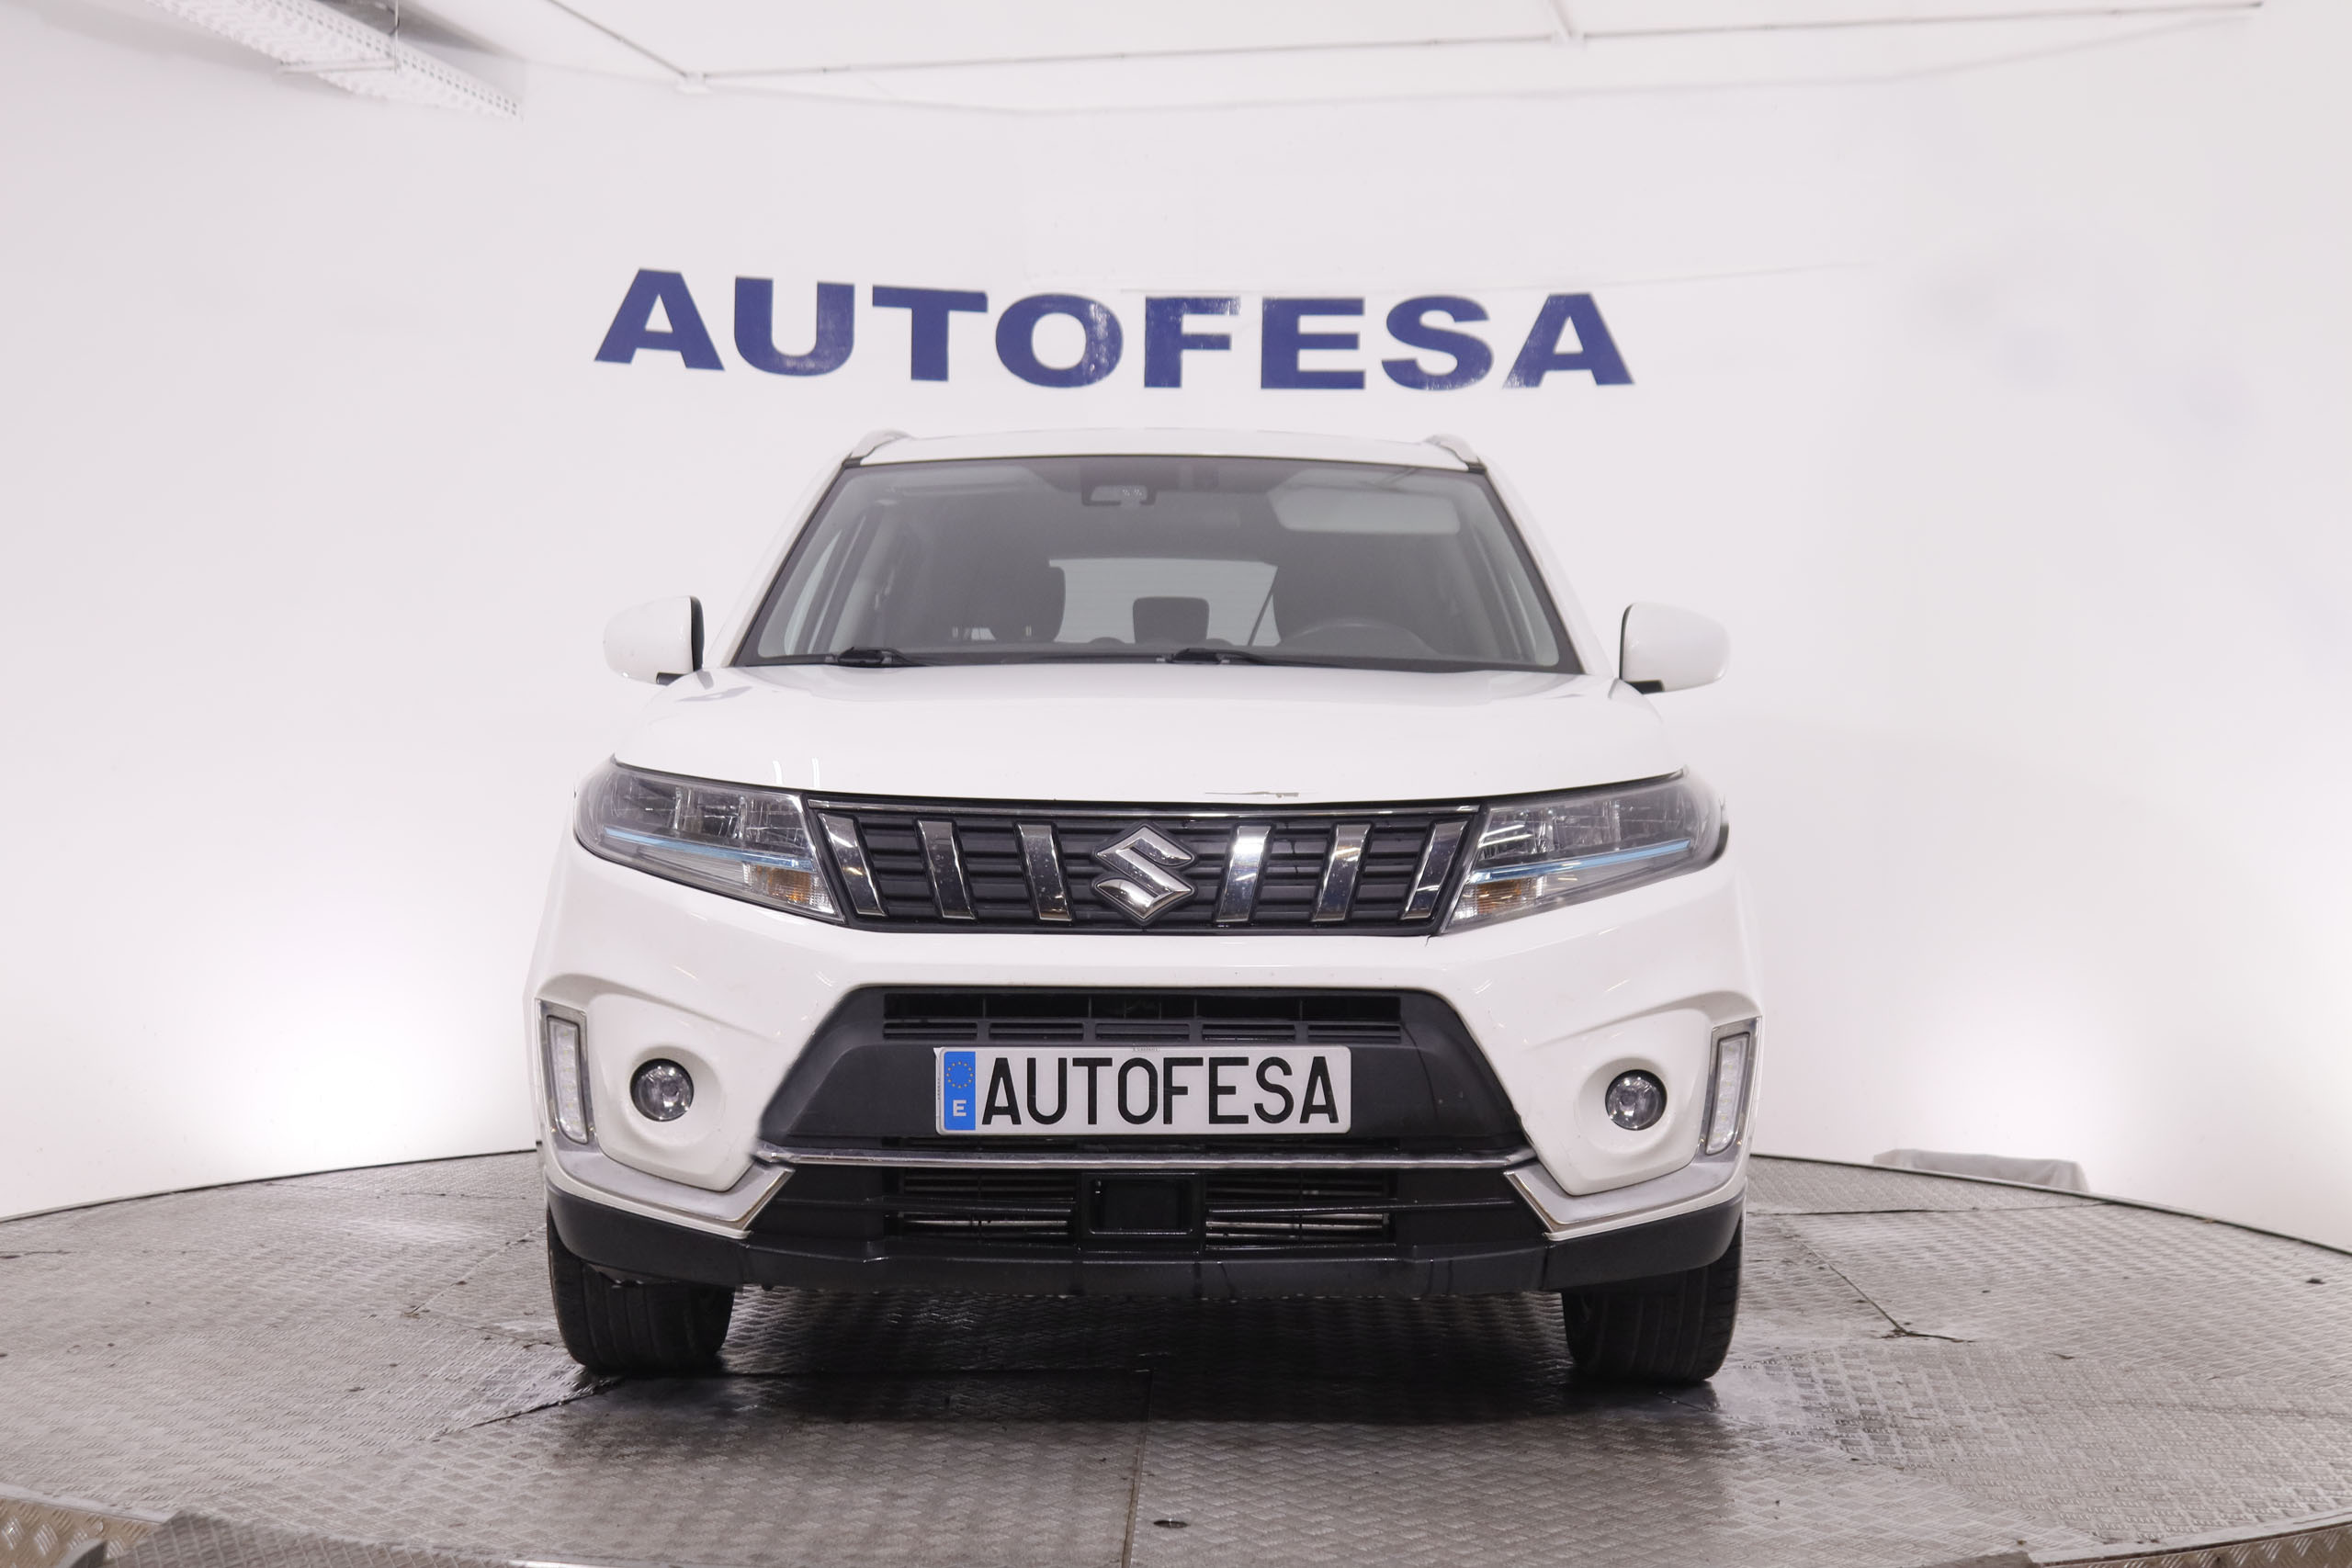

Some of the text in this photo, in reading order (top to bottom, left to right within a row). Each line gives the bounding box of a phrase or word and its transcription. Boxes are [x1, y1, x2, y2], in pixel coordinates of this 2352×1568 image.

[594, 268, 1636, 391] AUTOFESA
[953, 1100, 967, 1116] E
[981, 1056, 1340, 1125] AUTOFESA
